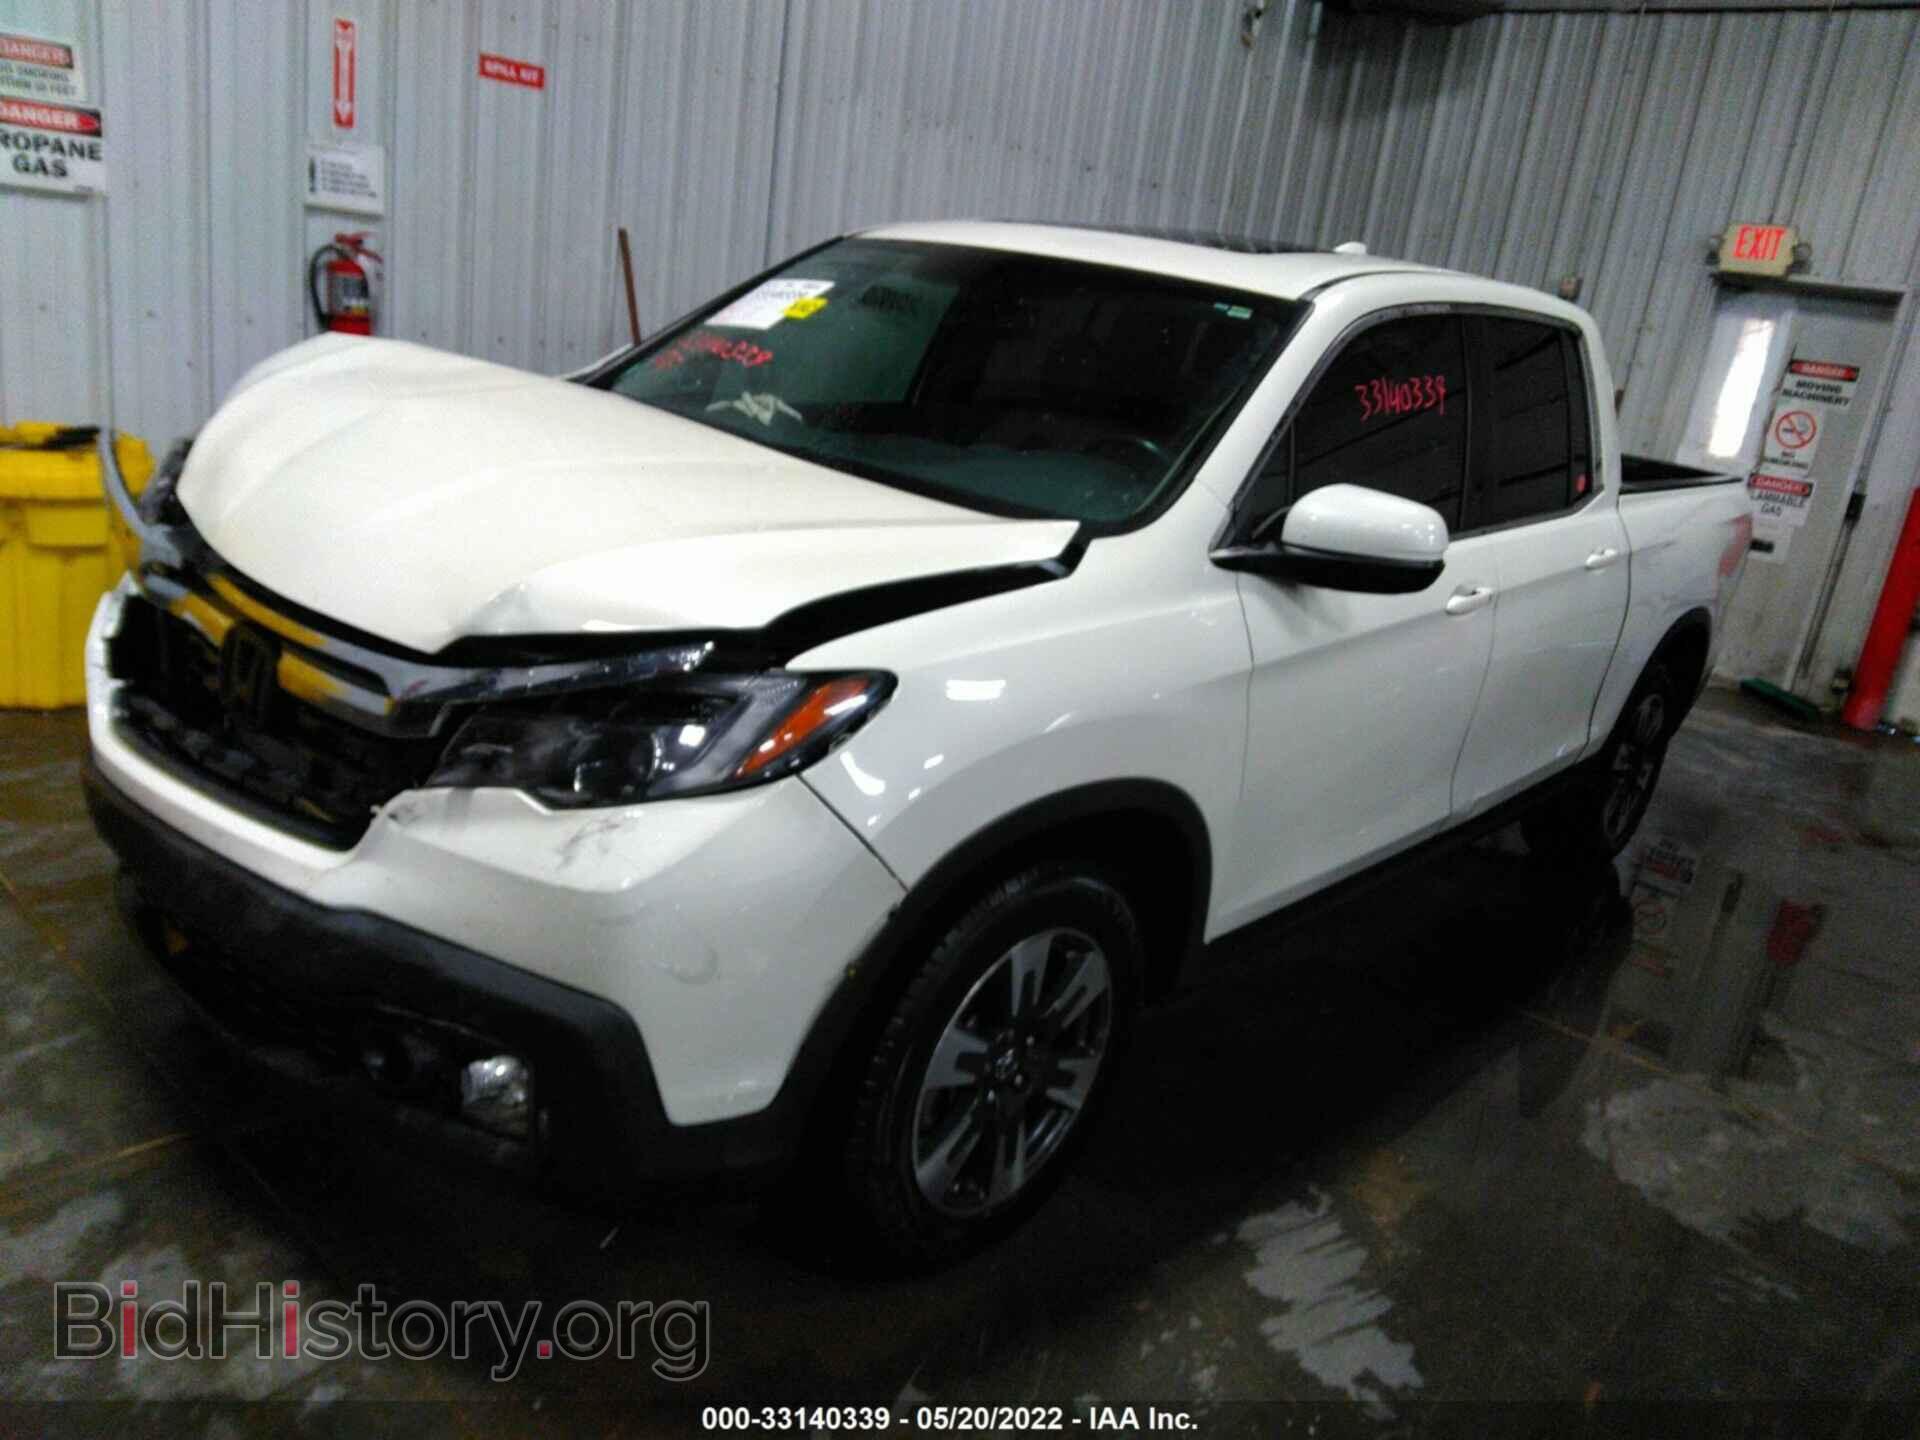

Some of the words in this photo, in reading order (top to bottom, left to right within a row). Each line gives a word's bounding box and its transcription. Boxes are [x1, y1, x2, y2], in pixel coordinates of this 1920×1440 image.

[12, 153, 68, 178] GAS
[1733, 225, 1785, 261] EXIT
[1782, 389, 1850, 406] MACHINERY
[1796, 380, 1842, 394] MOVING
[1354, 375, 1446, 422] 33140339
[1761, 503, 1782, 517] GAS
